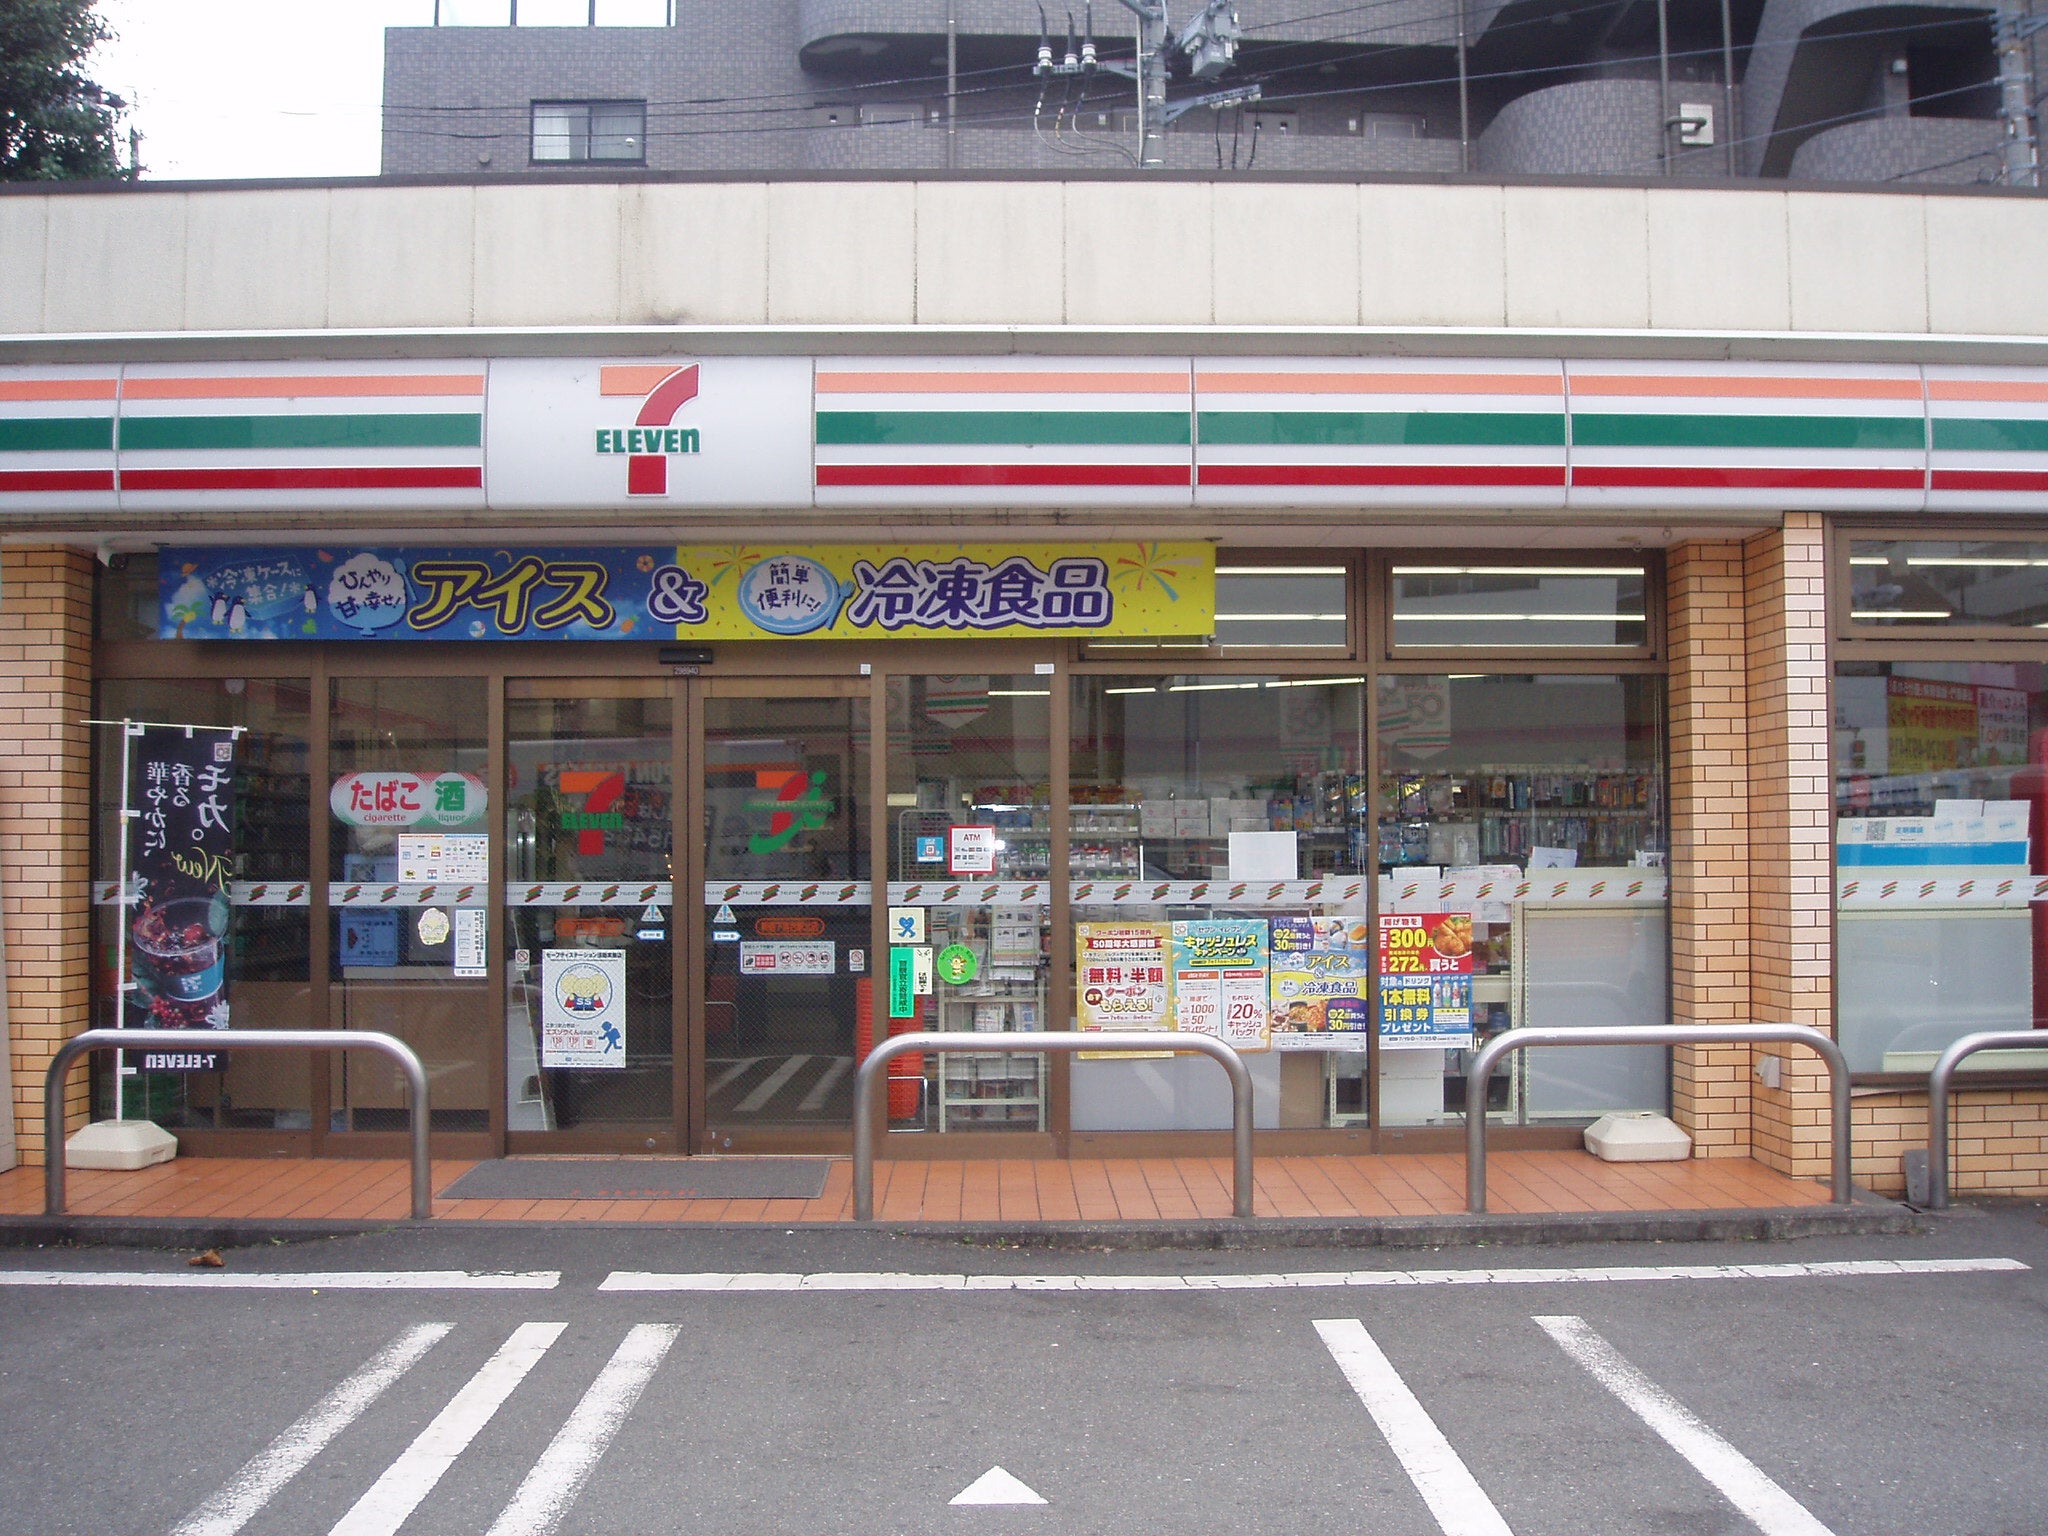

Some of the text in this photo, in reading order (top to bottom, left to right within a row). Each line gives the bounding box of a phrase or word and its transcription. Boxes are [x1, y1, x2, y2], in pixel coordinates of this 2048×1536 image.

[339, 568, 391, 590] ひんやり
[769, 563, 810, 585] 簡単
[409, 558, 612, 632] アイス
[651, 566, 707, 623] &
[849, 557, 1113, 630] 冷凍食品
[350, 780, 421, 811] たばこ
[434, 780, 466, 812] 酒
[363, 814, 407, 823] cigarette
[438, 814, 466, 822] liquor
[963, 833, 981, 841] ATM
[1184, 934, 1257, 948] キャッシュレス
[1194, 947, 1236, 957] キャンペーン
[1306, 954, 1351, 970] アイス
[1429, 958, 1459, 972] 買うと
[1105, 986, 1147, 998] クーポン
[1302, 981, 1357, 996] 冷凍食品
[1380, 987, 1431, 1006] 1本無料
[1231, 1003, 1263, 1020] 20%
[1384, 1008, 1429, 1021] 引換券
[1381, 1022, 1431, 1033] プレゼント
